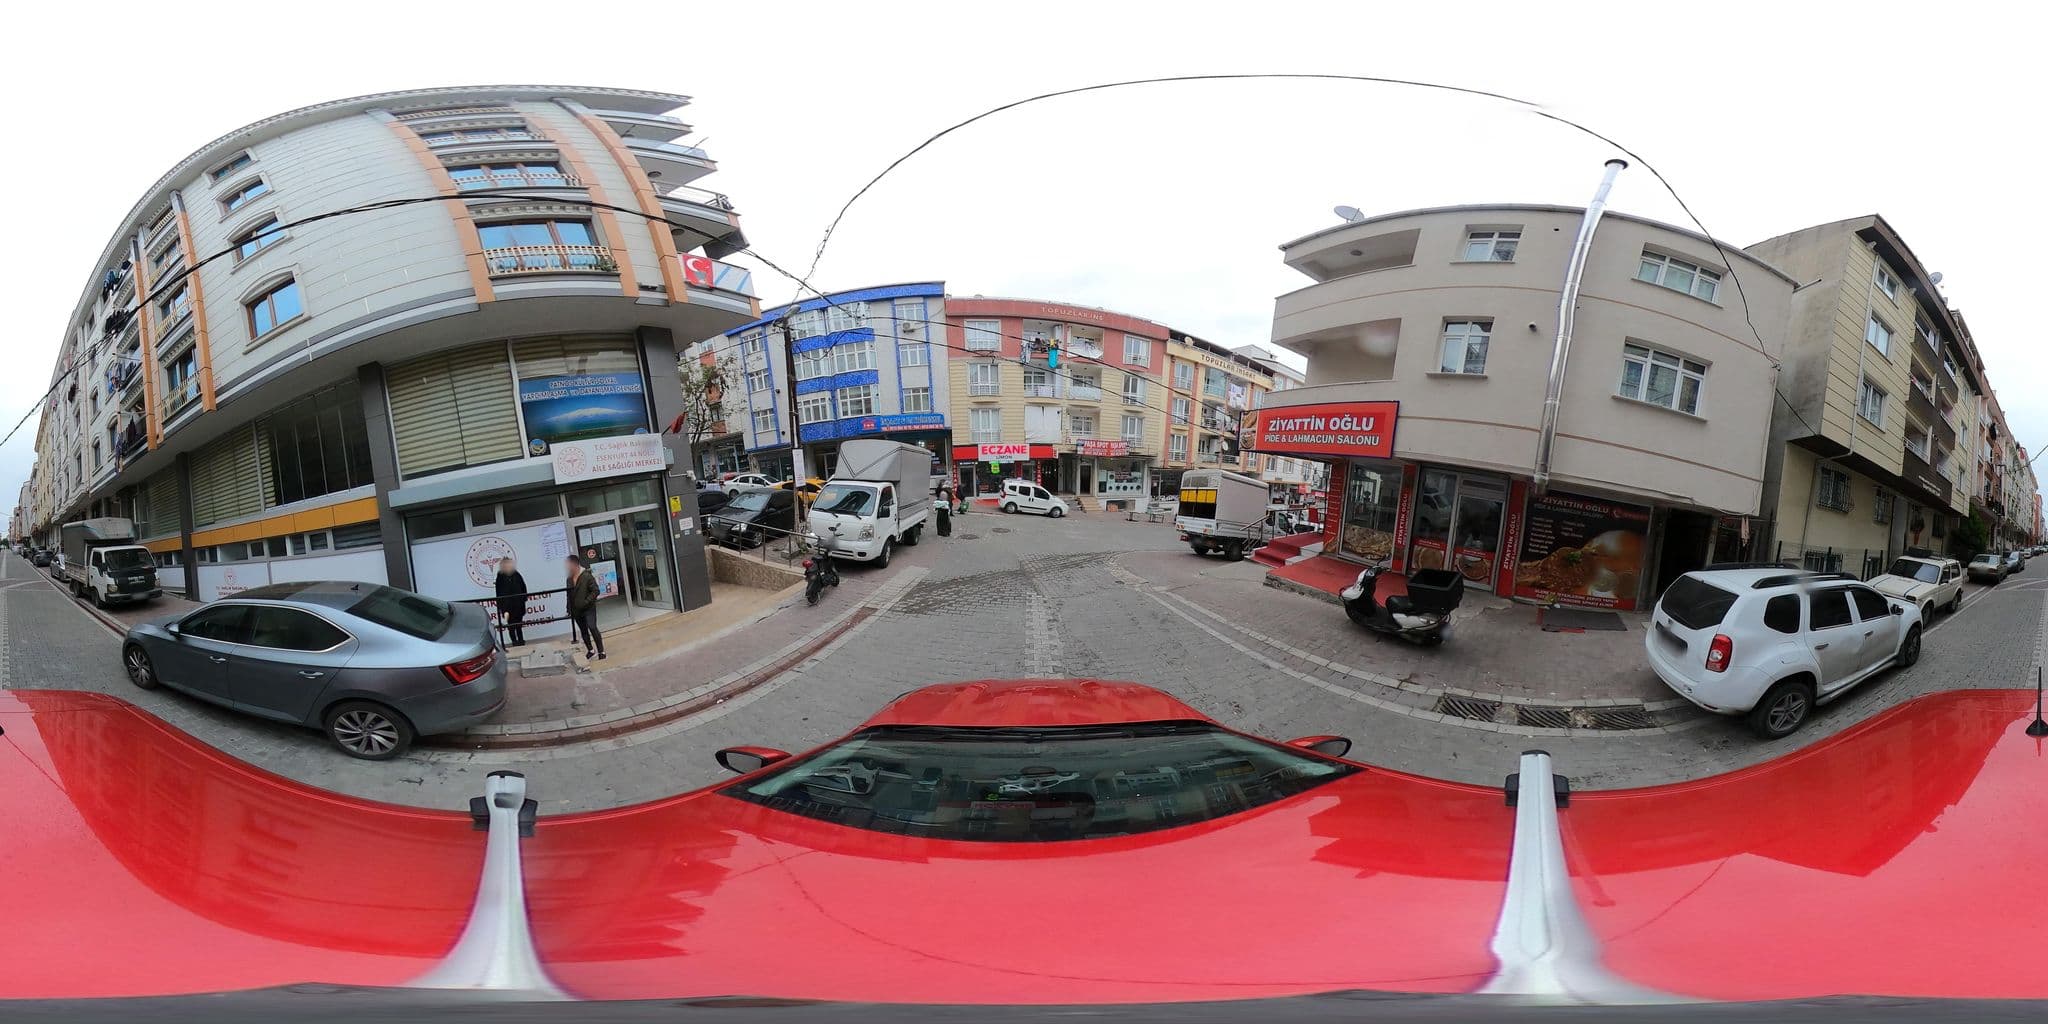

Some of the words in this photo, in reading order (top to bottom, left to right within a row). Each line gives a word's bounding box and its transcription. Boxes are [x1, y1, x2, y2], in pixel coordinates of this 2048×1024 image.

[1268, 415, 1324, 432] ZİYATTİN
[1329, 413, 1375, 431] OĞLU
[1288, 434, 1335, 444] LAHMACUN
[1337, 435, 1379, 446] SALONU
[981, 445, 1027, 455] ECZANE
